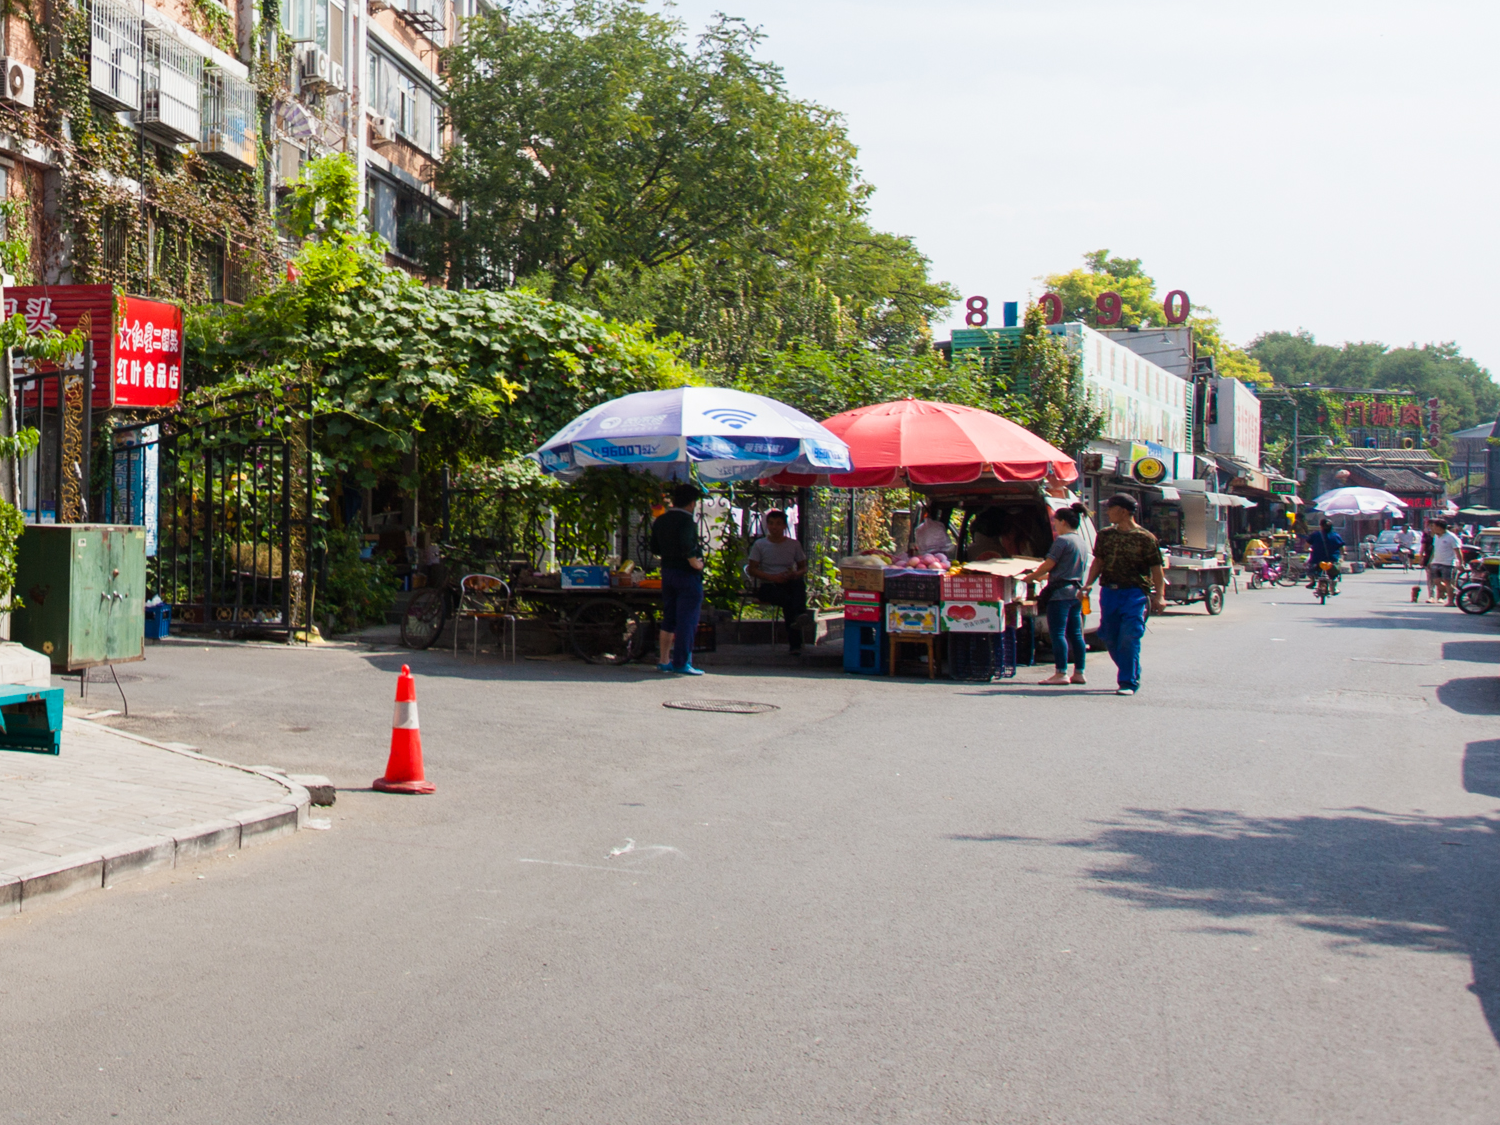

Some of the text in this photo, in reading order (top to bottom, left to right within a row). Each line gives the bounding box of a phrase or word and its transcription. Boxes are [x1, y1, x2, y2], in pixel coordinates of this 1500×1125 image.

[131, 318, 179, 354] 红星二锅头
[116, 357, 180, 390] 红叶食品店
[600, 445, 642, 458] 96007
